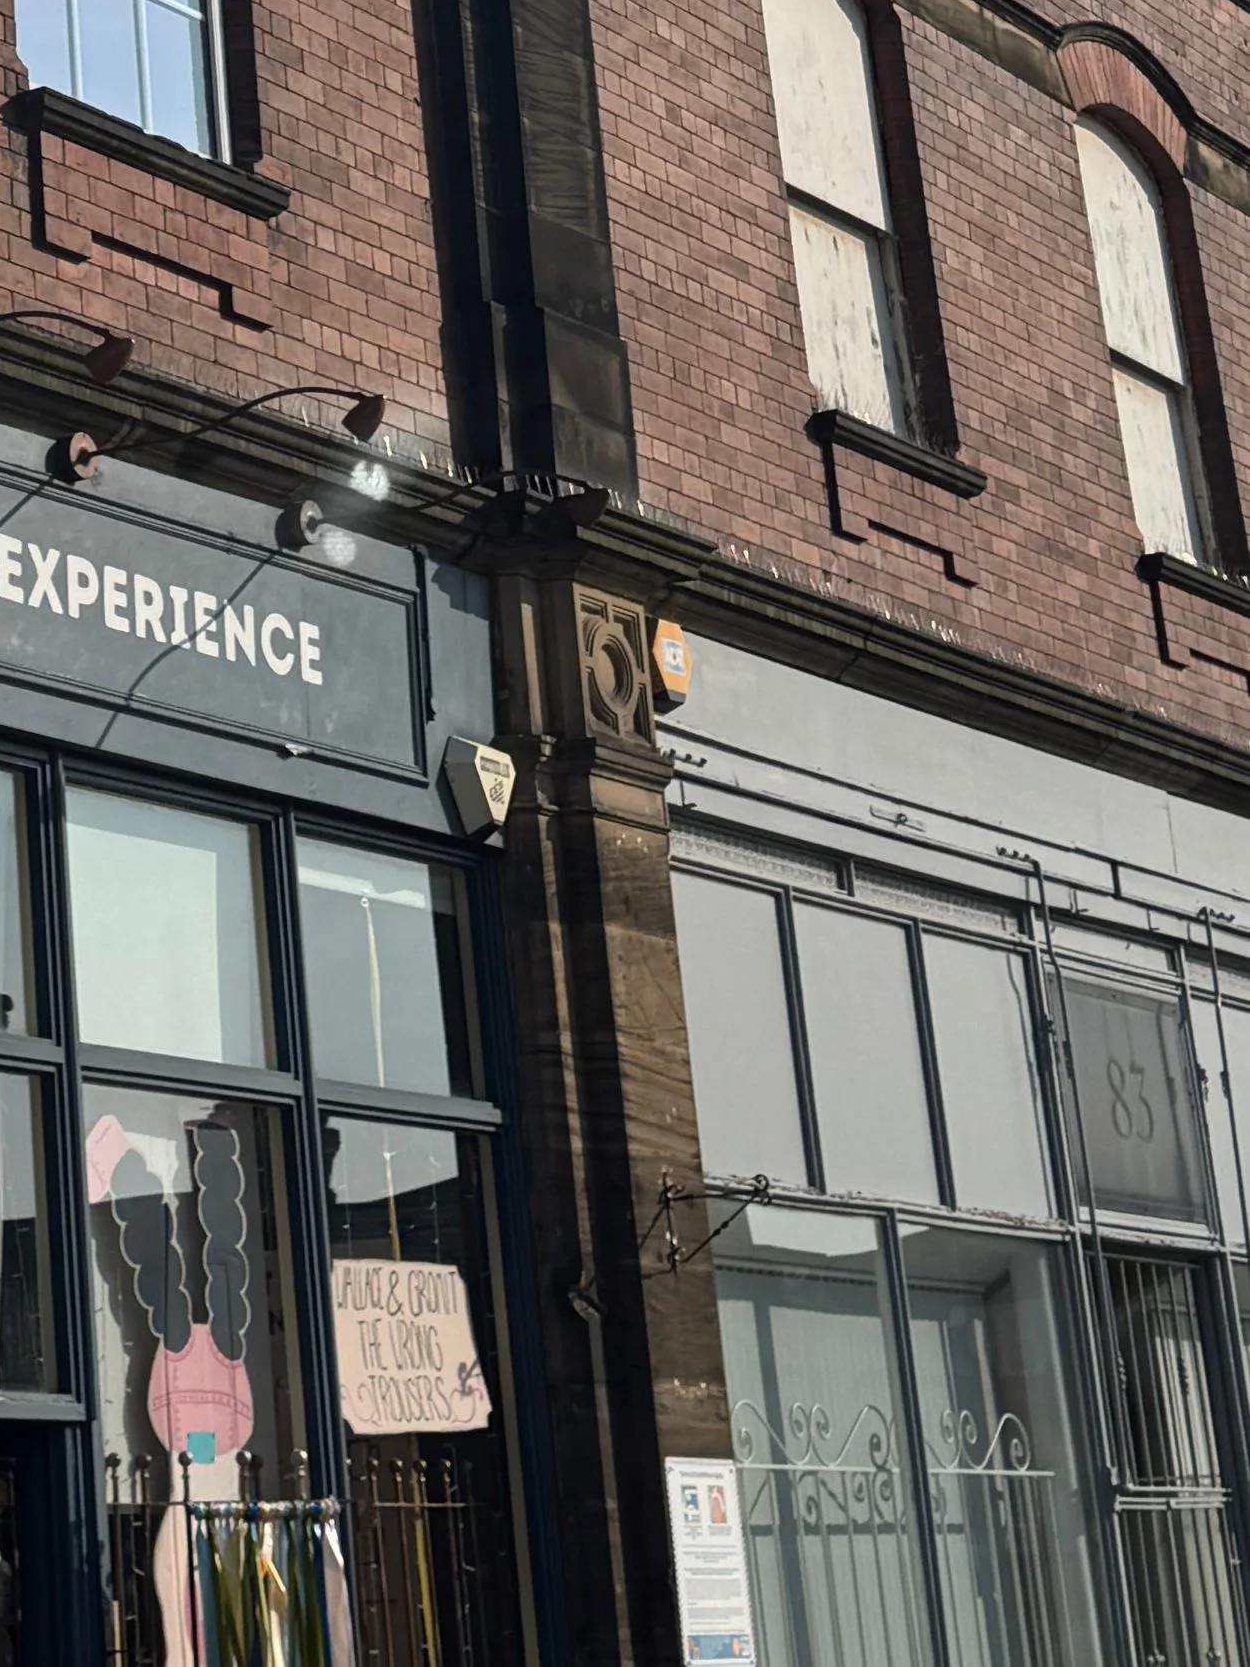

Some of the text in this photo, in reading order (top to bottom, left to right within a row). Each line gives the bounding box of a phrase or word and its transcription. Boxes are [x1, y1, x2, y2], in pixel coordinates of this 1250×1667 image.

[1106, 1056, 1155, 1144] 83
[386, 1269, 406, 1316] &
[357, 1318, 388, 1371] THE
[367, 1374, 451, 1424] TROUSERS
